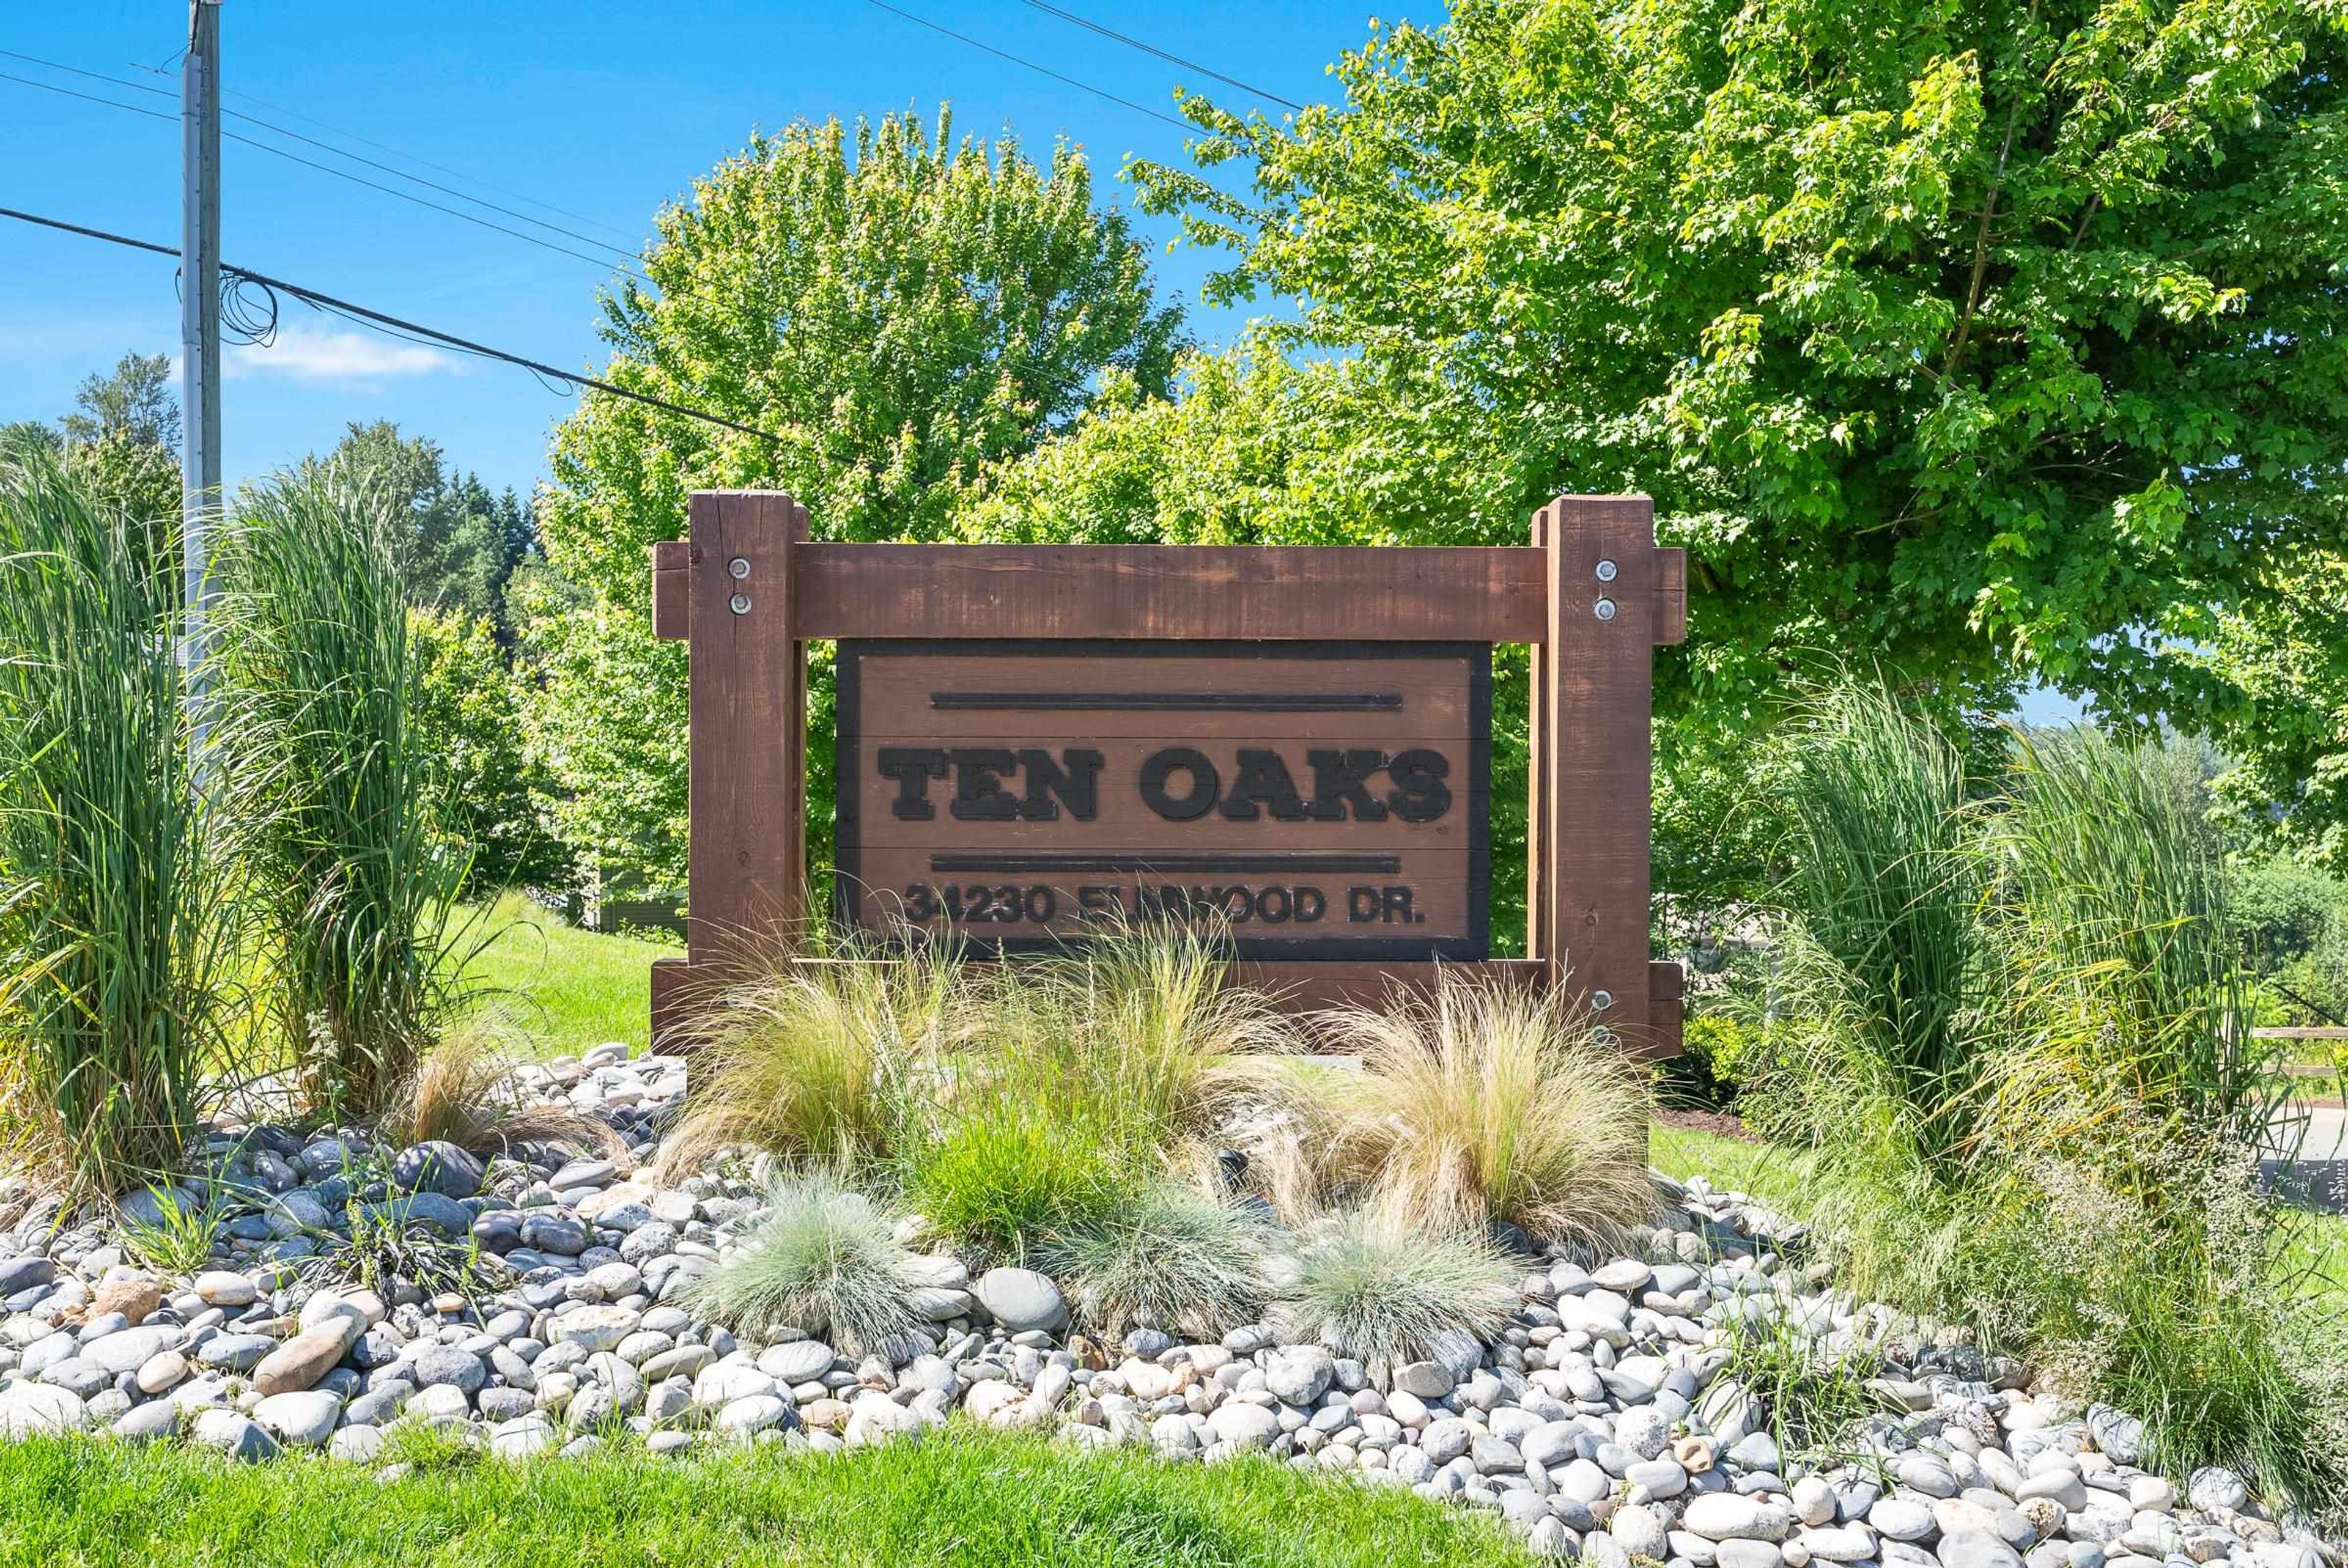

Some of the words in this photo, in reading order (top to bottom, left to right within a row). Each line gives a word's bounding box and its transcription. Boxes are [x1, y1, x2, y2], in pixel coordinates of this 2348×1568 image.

[878, 748, 1104, 822] TEN
[1140, 747, 1452, 823] OAKS
[904, 883, 1056, 923] 34230
[1348, 885, 1425, 924] DR.
